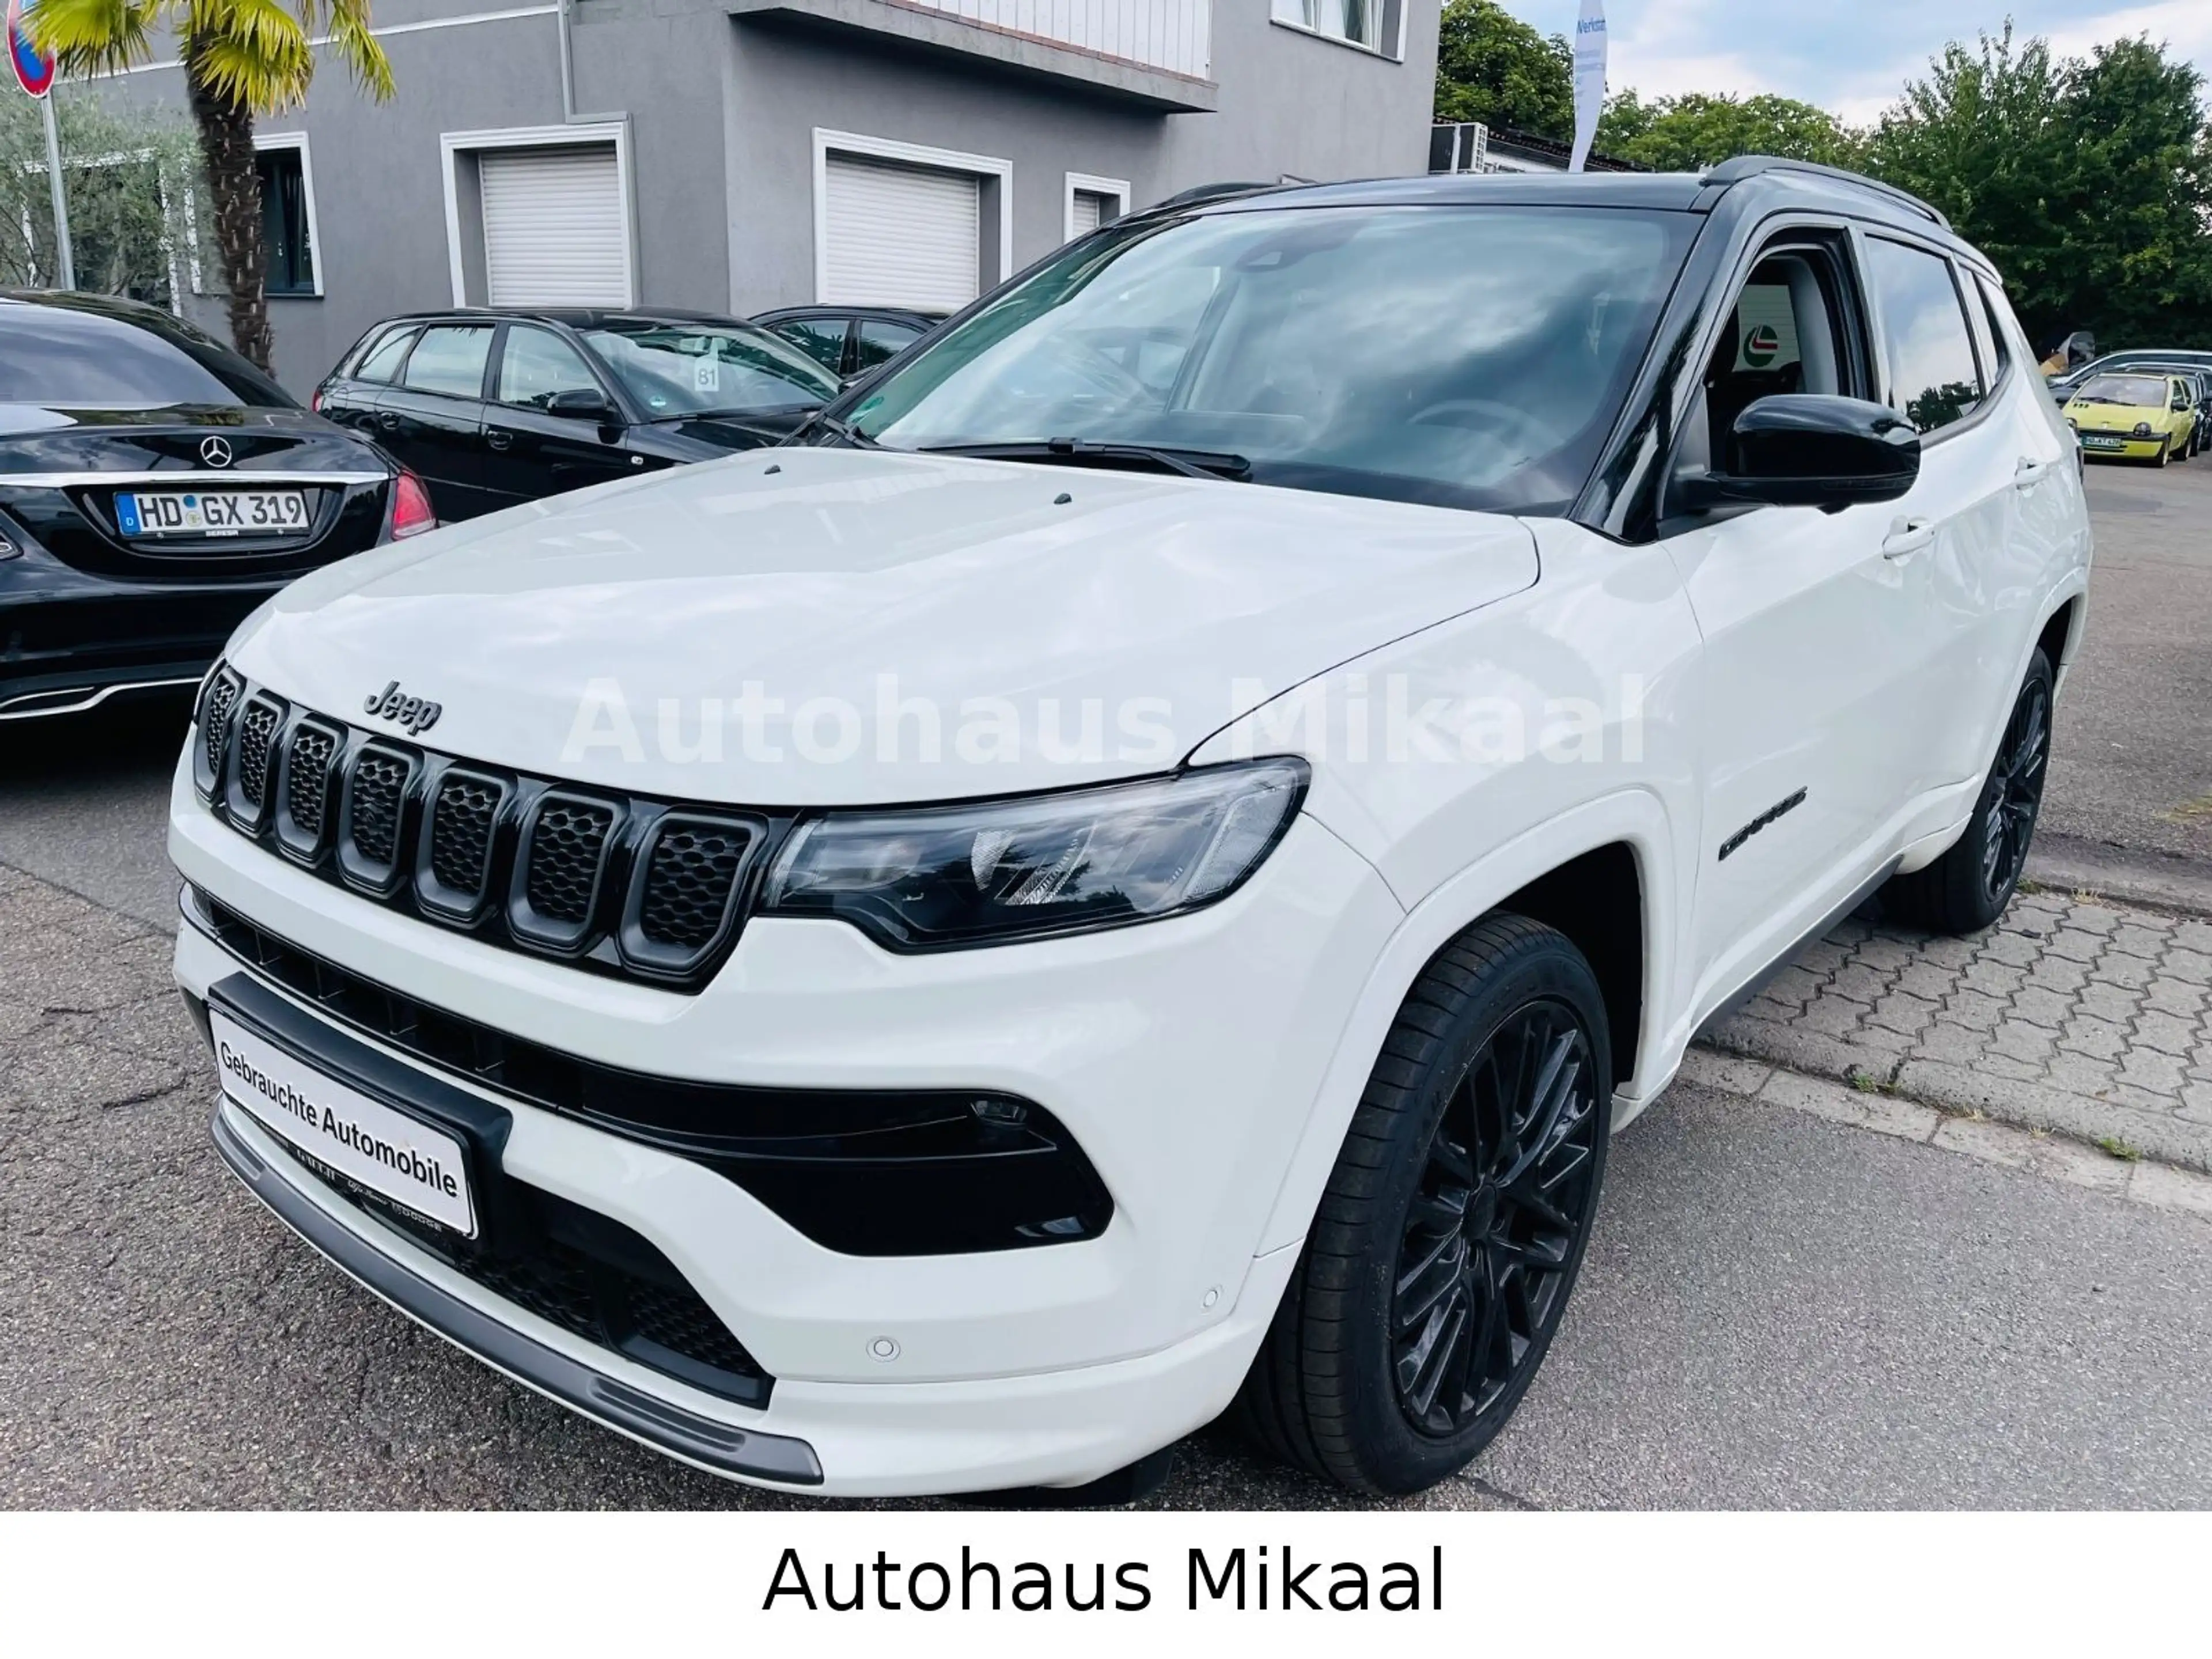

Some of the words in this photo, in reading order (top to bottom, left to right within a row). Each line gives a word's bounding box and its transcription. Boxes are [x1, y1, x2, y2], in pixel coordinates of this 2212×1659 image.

[698, 368, 715, 385] 81
[138, 497, 182, 528] HD
[202, 496, 244, 525] GX
[249, 495, 302, 524] 319
[363, 680, 442, 737] Jeep
[220, 1041, 317, 1127] Gebrauchte
[322, 1107, 458, 1198] Automobile
